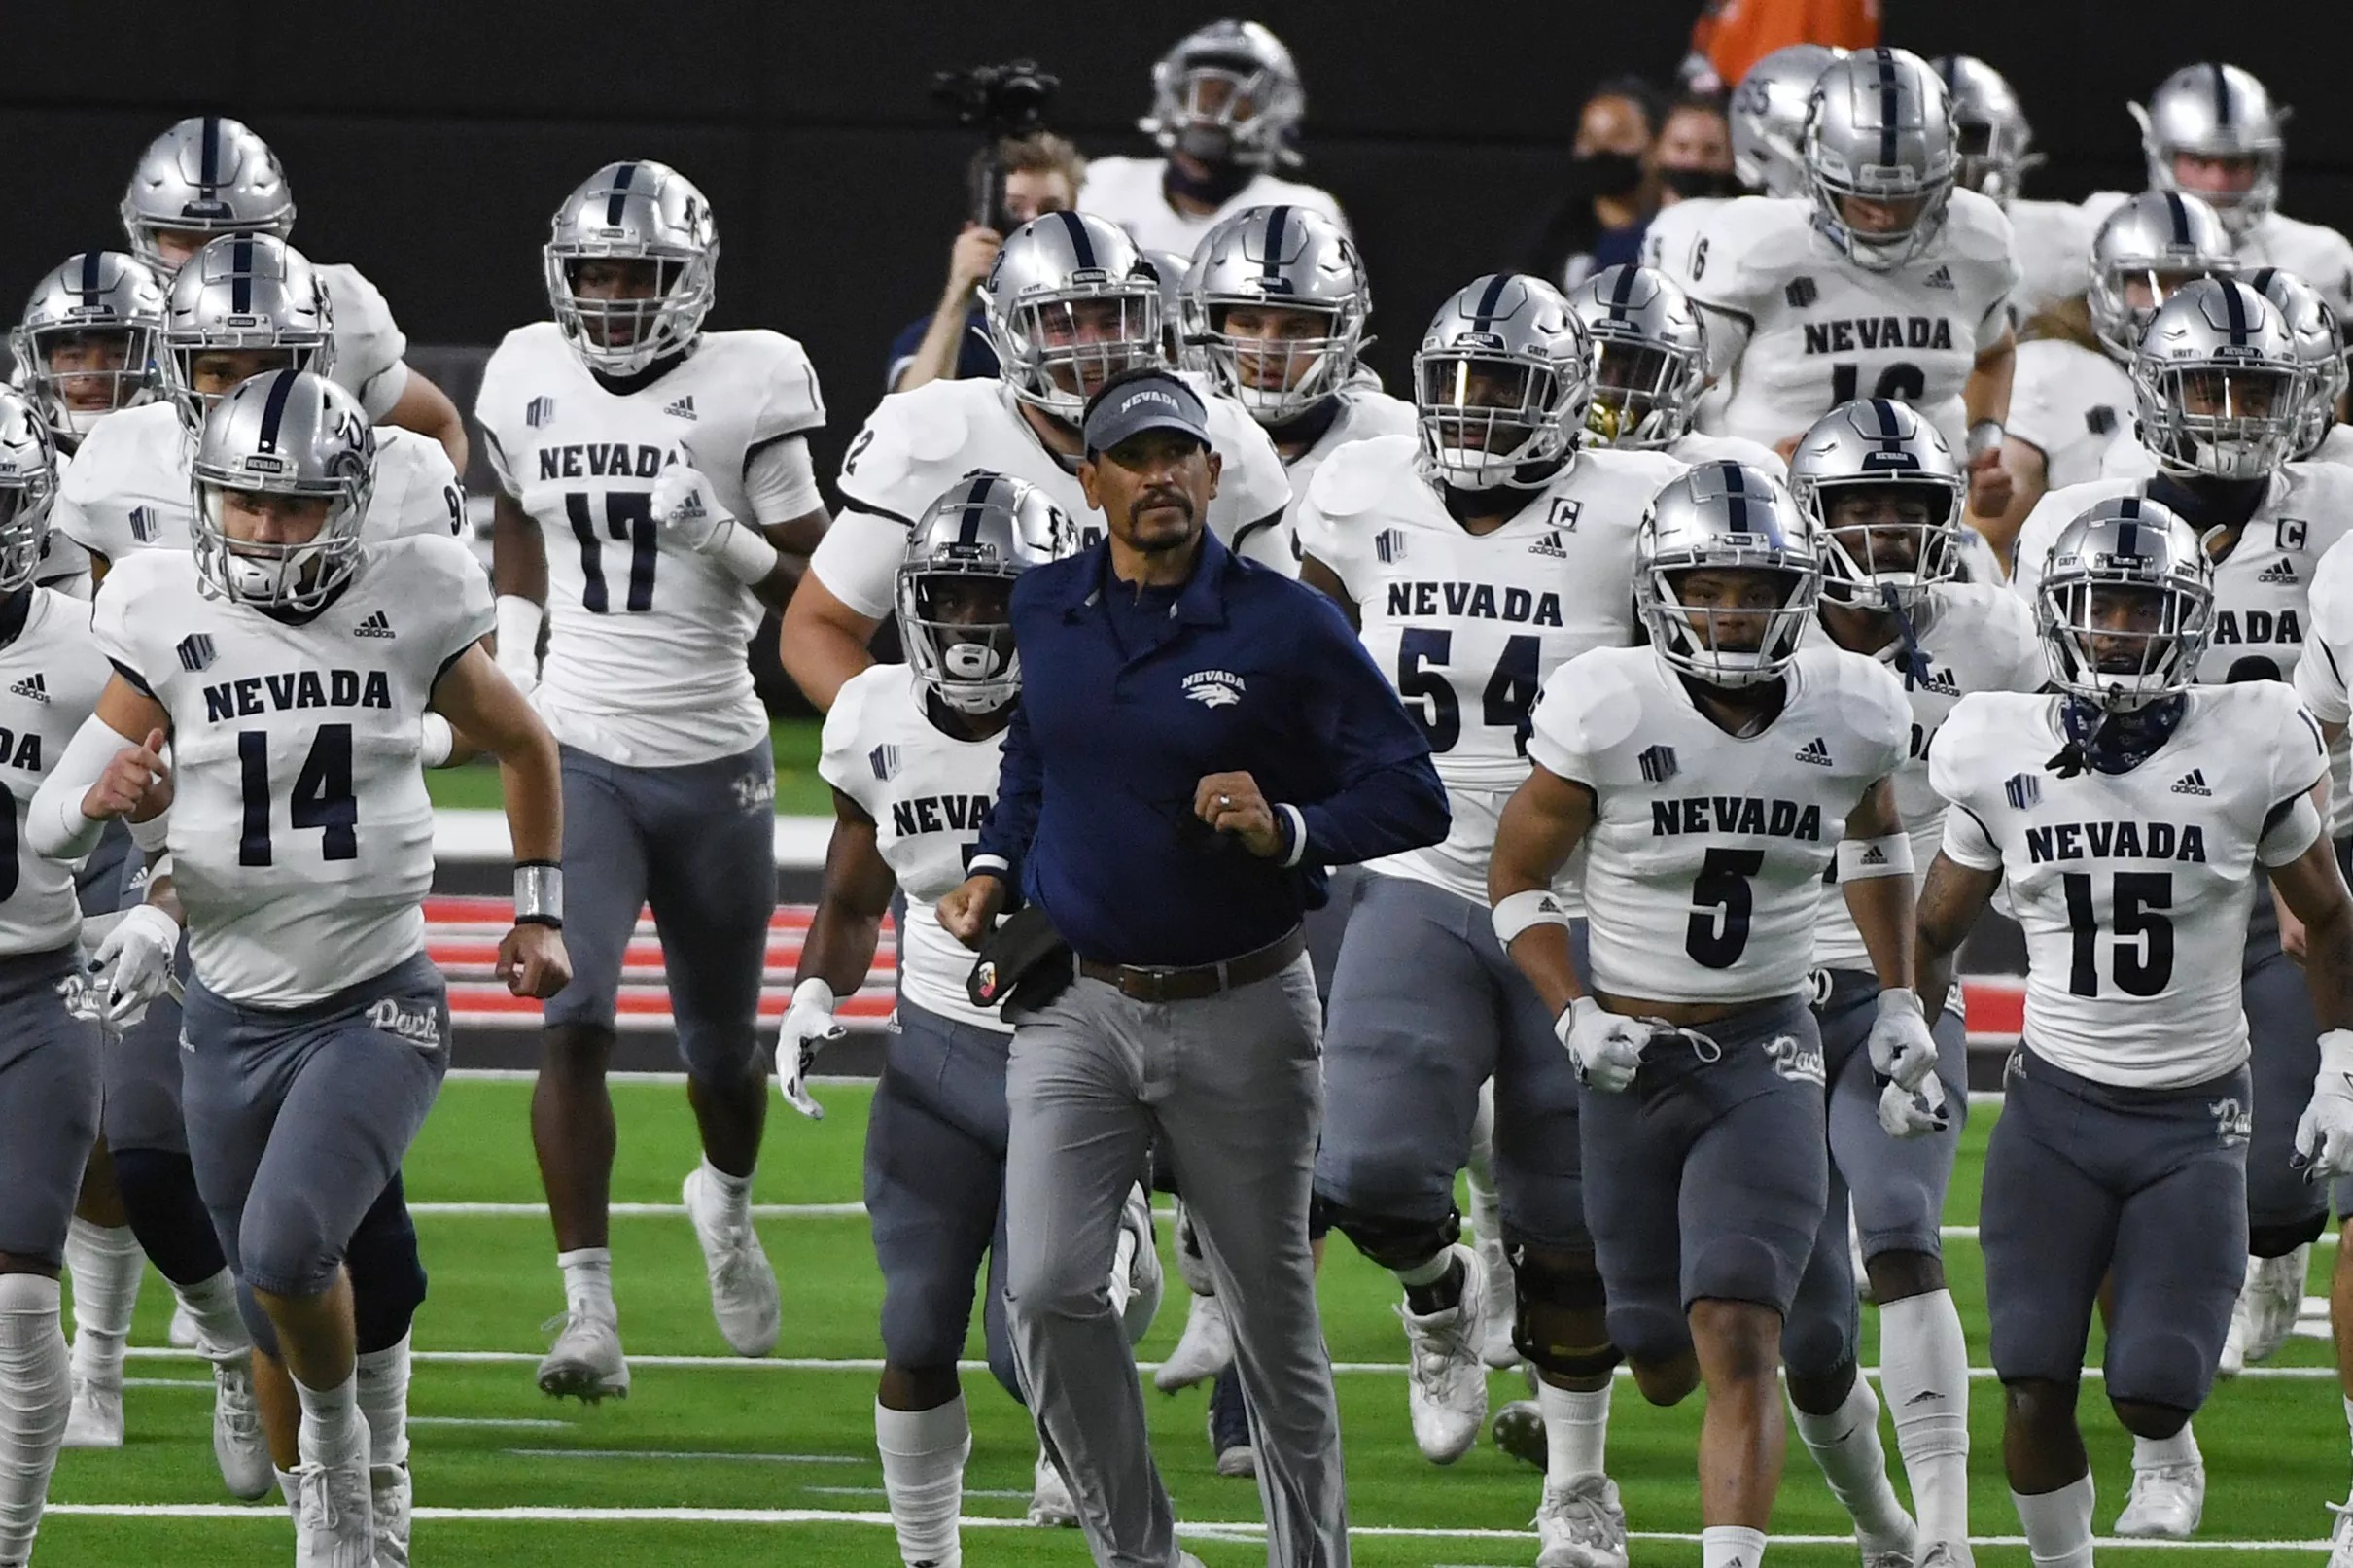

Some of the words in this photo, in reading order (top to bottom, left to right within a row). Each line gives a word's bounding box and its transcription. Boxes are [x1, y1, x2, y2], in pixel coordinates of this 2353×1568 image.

[1528, 344, 1549, 357] GRIT
[1804, 317, 1953, 354] NEVADA
[1121, 390, 1179, 414] NEVADA
[846, 429, 875, 477] 2
[1552, 500, 1581, 529] C
[565, 491, 658, 613] 17
[1528, 544, 1567, 559] adidas
[2279, 520, 2304, 550] C
[1387, 581, 1563, 627] NEVADA
[354, 627, 396, 639] adidas
[2213, 610, 2302, 645] ADA
[11, 684, 51, 704] adidas
[203, 669, 392, 723] NEVADA
[1180, 669, 1247, 691] NEVADA
[1397, 627, 1541, 758] 54
[1922, 682, 1961, 698] adidas
[1795, 751, 1833, 767] adidas
[238, 723, 359, 867] 14
[2170, 784, 2213, 797] adidas
[892, 794, 990, 837] NEVA
[1651, 796, 1821, 842] NEVADA
[2025, 821, 2206, 864] NEVADA
[1685, 847, 1765, 969] 5
[2062, 872, 2174, 998] 15
[364, 997, 440, 1049] Pack
